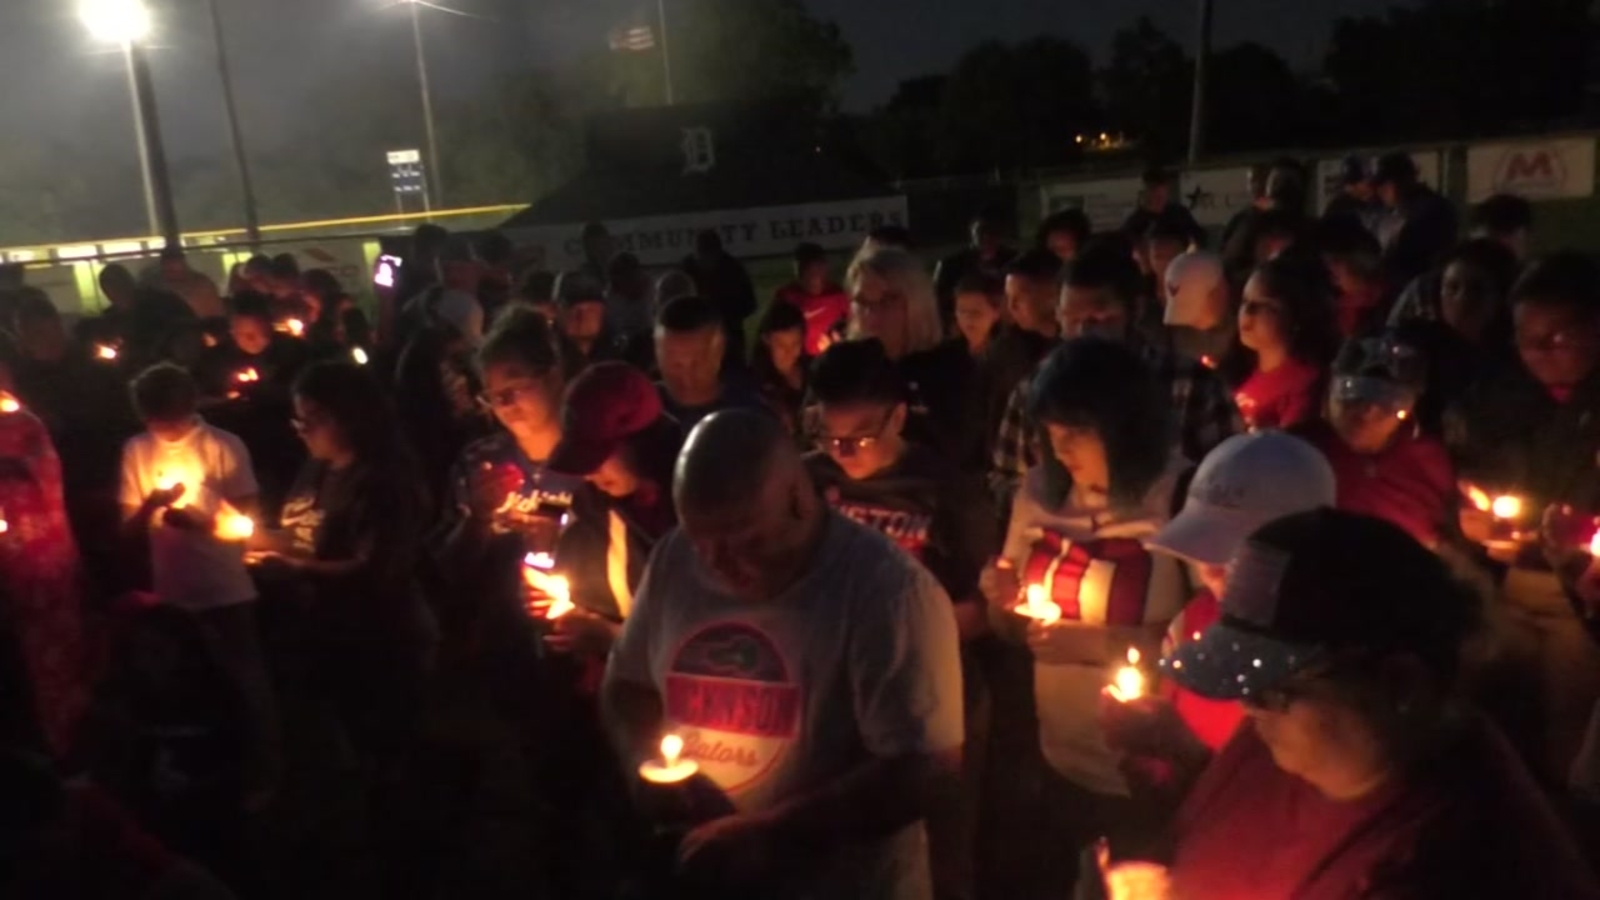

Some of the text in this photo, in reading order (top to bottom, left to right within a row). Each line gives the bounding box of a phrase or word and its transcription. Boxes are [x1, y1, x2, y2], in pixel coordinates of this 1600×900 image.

[680, 127, 716, 176] D
[1505, 152, 1552, 181] M
[563, 209, 902, 256] CMMUNTY LEADERS
[680, 730, 761, 767] Gators
